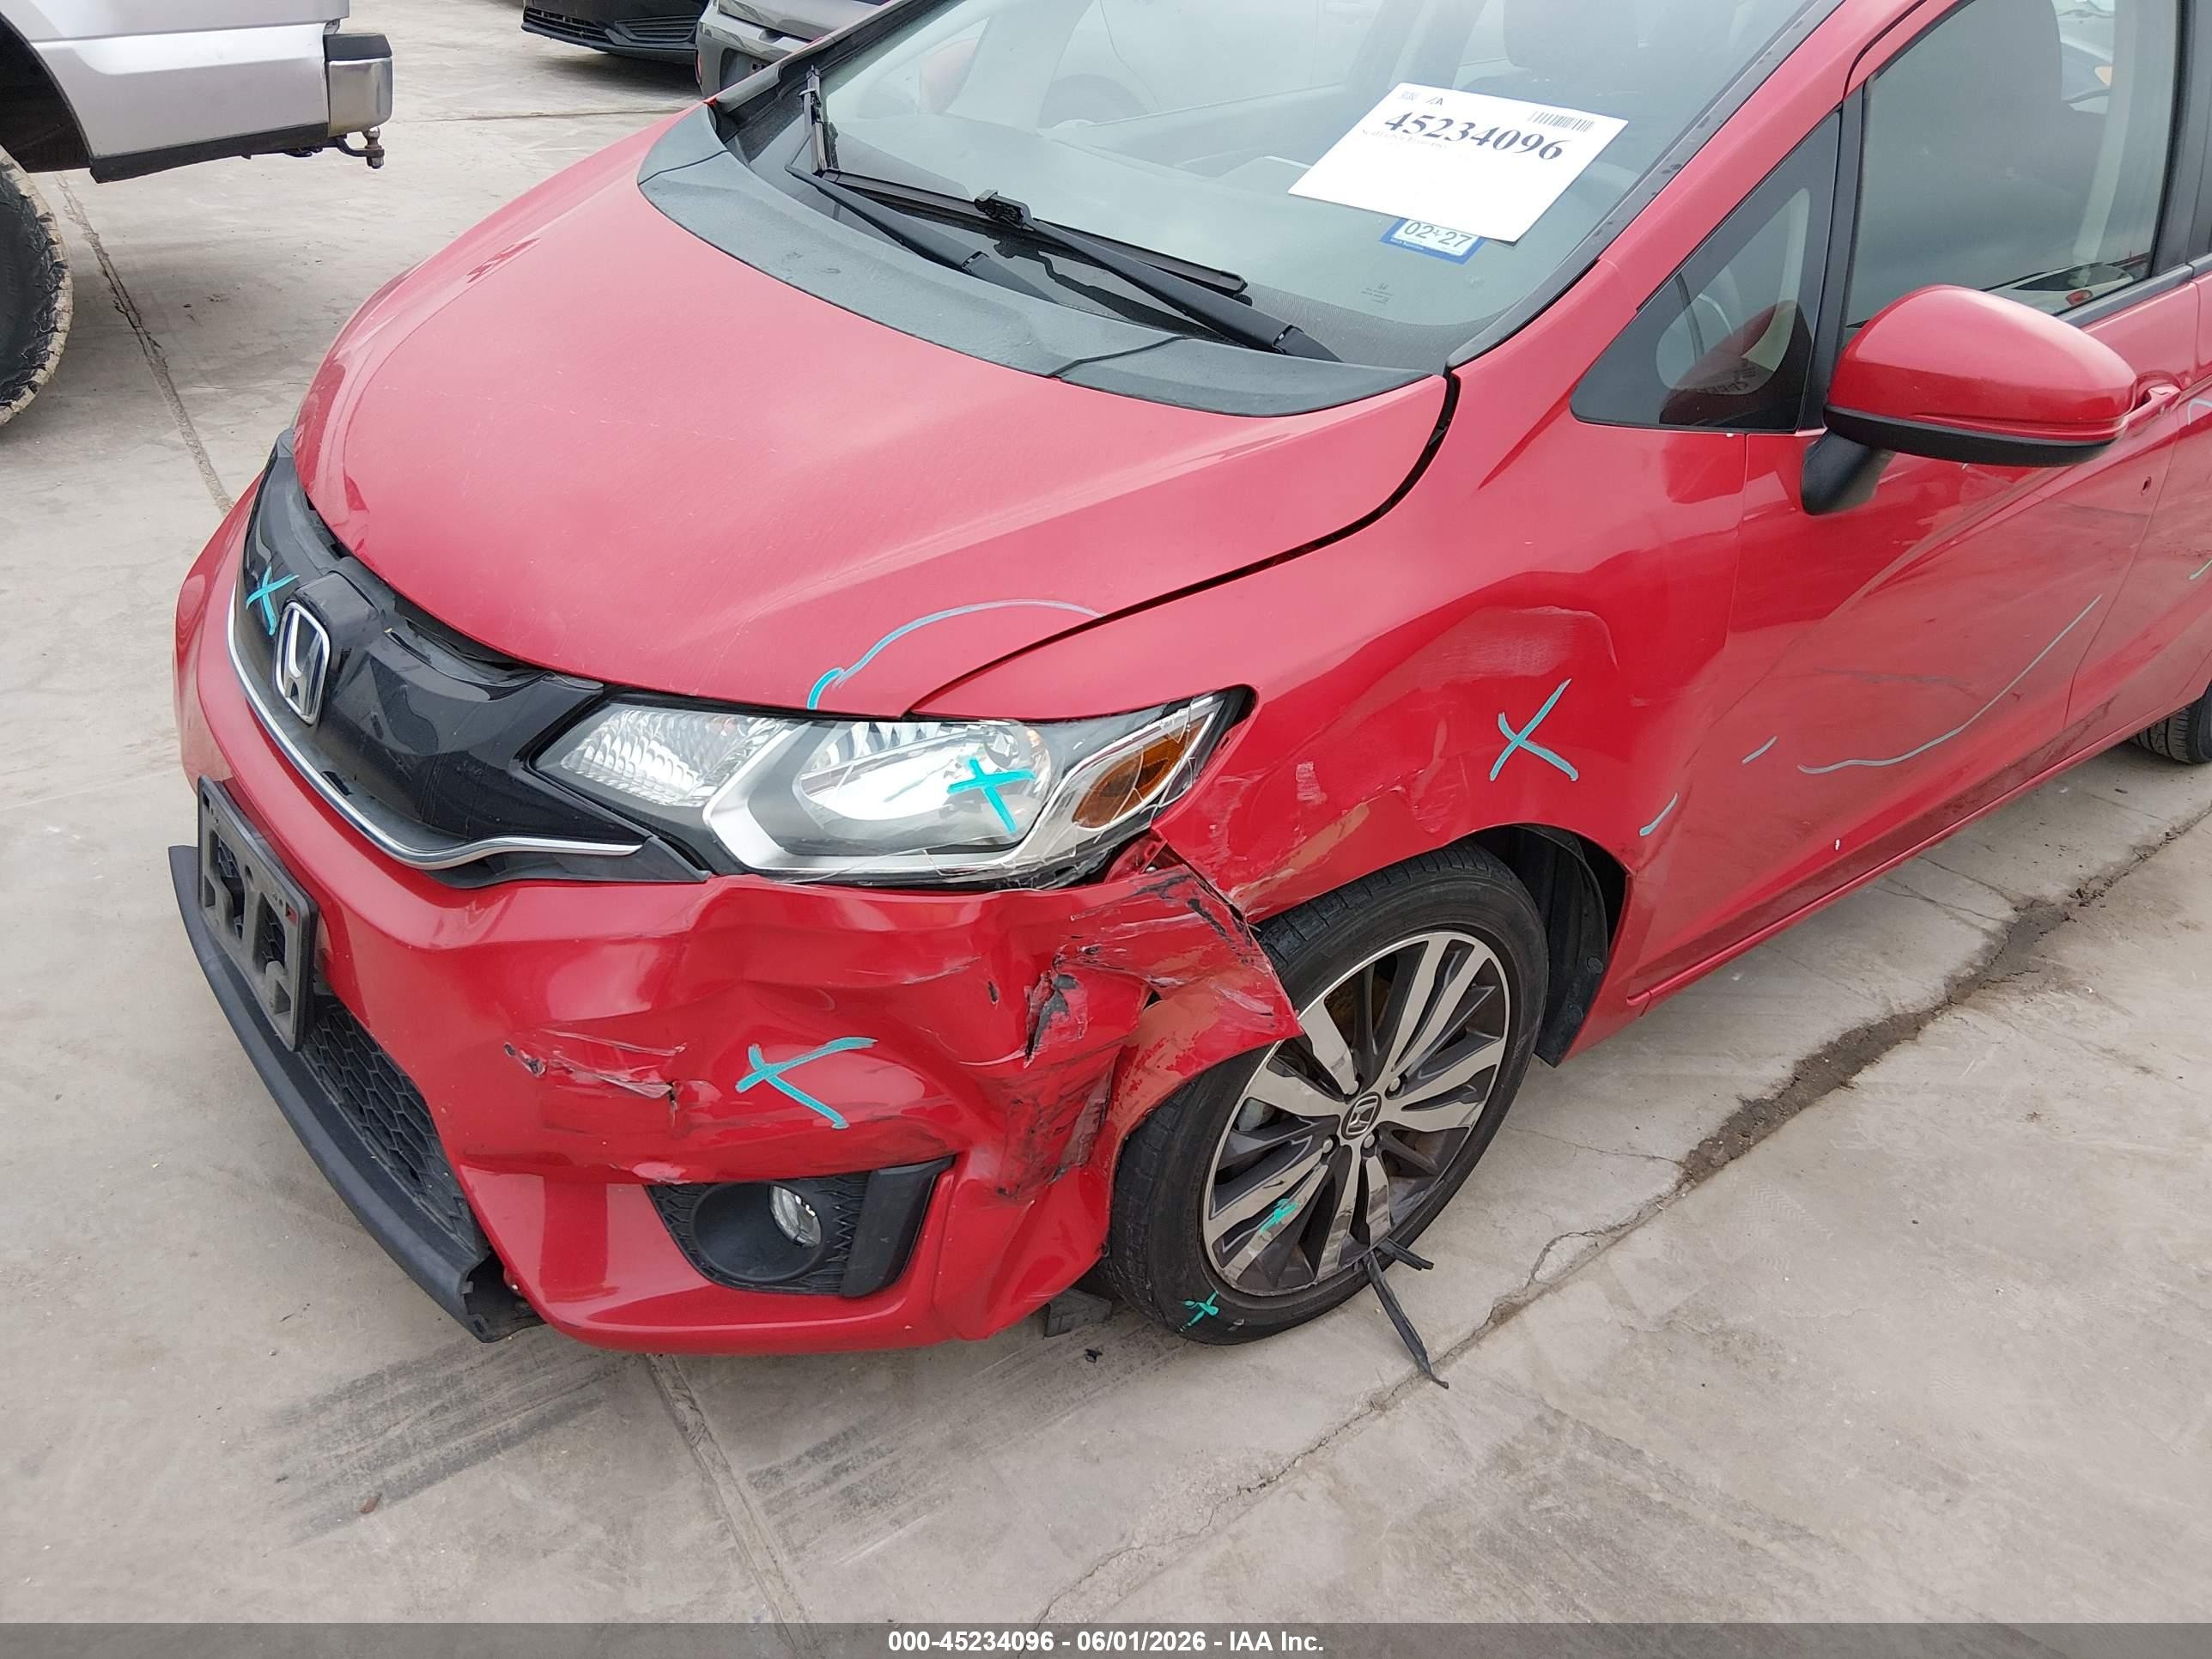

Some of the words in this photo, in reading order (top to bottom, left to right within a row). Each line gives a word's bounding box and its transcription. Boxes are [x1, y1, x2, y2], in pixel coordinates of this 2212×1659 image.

[1383, 111, 1572, 161] 45234096
[1403, 221, 1435, 240] 02
[1437, 230, 1473, 248] 27
